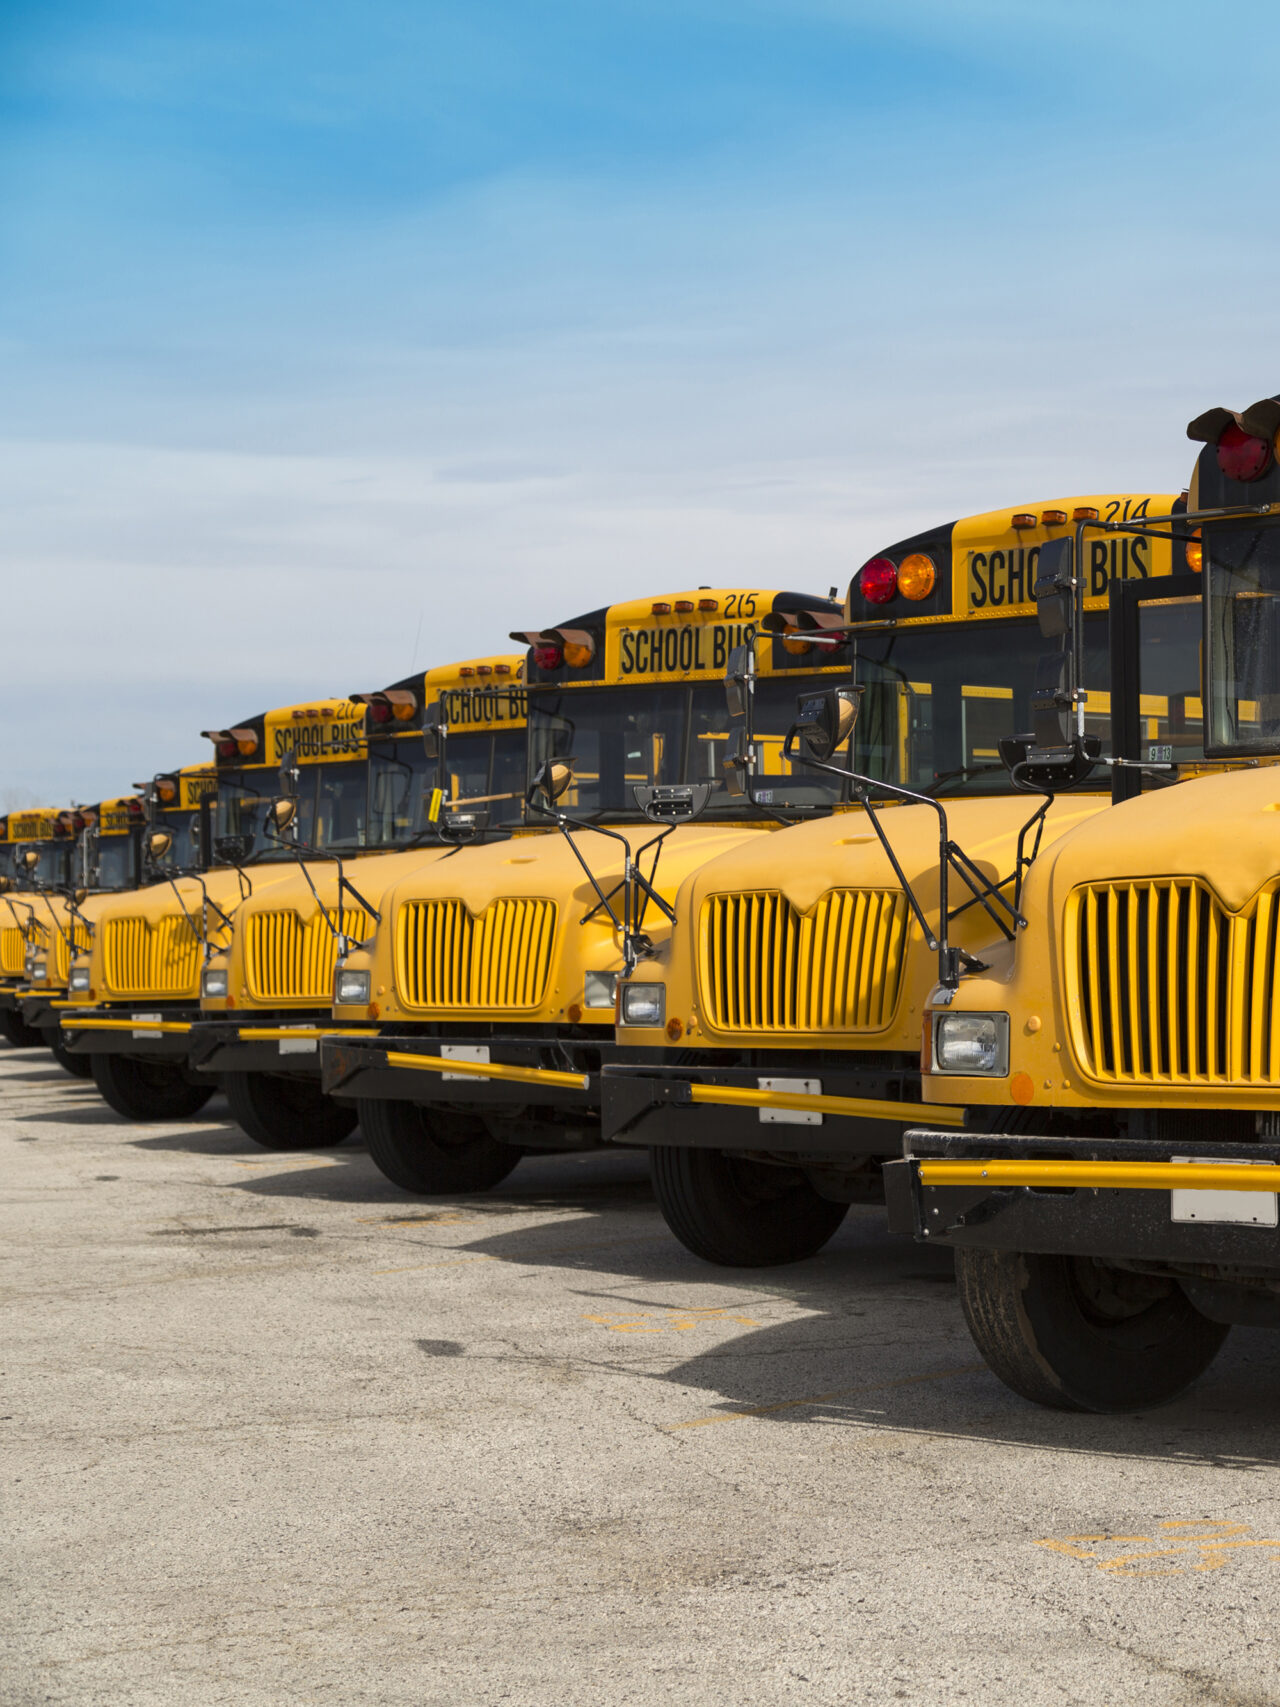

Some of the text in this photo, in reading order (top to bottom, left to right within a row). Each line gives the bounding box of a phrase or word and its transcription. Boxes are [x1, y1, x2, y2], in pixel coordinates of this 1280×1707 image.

[1104, 498, 1151, 531] 214
[970, 546, 1041, 608] SCHO
[724, 593, 759, 619] 215
[621, 625, 705, 674] SCHOOL
[440, 684, 528, 725] SCHOOL BU
[275, 722, 360, 760] SCHOOL BUS
